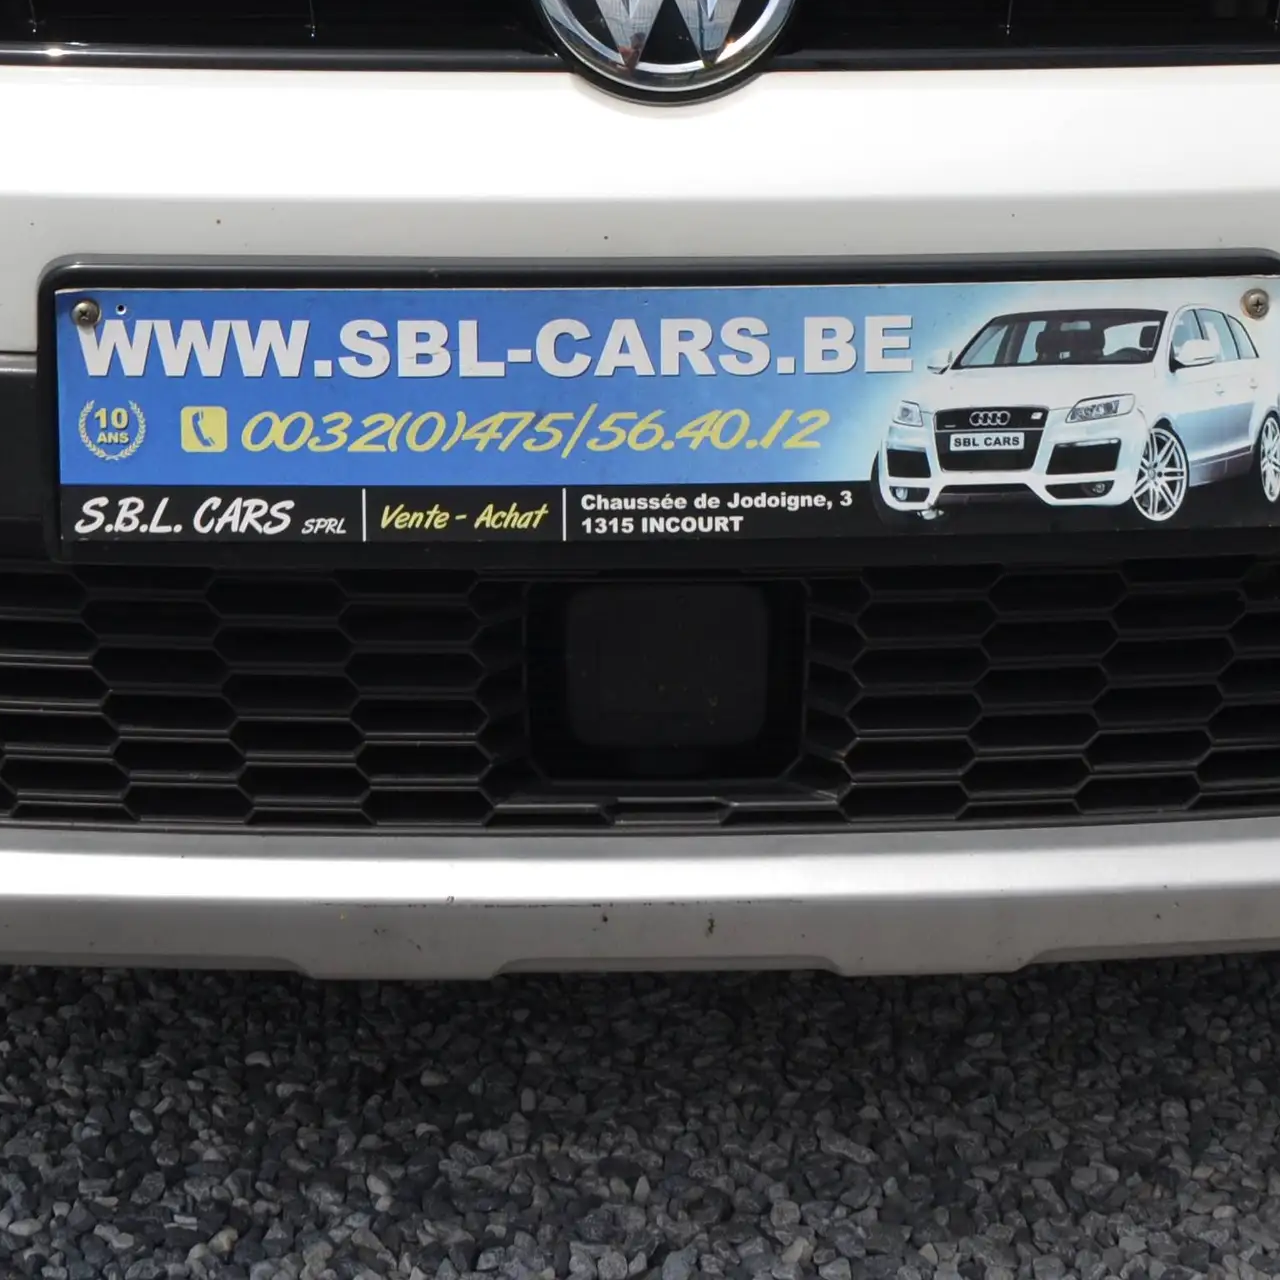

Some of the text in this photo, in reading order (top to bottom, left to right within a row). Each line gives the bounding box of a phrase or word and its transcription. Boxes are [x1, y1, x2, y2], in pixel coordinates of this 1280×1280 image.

[76, 315, 914, 378] WWW.SBL-CARS.BE
[94, 407, 129, 429] 10
[96, 431, 130, 445] ANS
[241, 403, 830, 458] 0032(0)475/56.40.12
[954, 436, 1020, 447] SBL CARS
[581, 491, 853, 511] Chaussée de Jodoigne, 3
[74, 496, 346, 535] S.B.L. CARS SPRL
[380, 503, 450, 530] Vente
[474, 502, 549, 529] Achat
[581, 516, 744, 533] 1315 INCOURT
